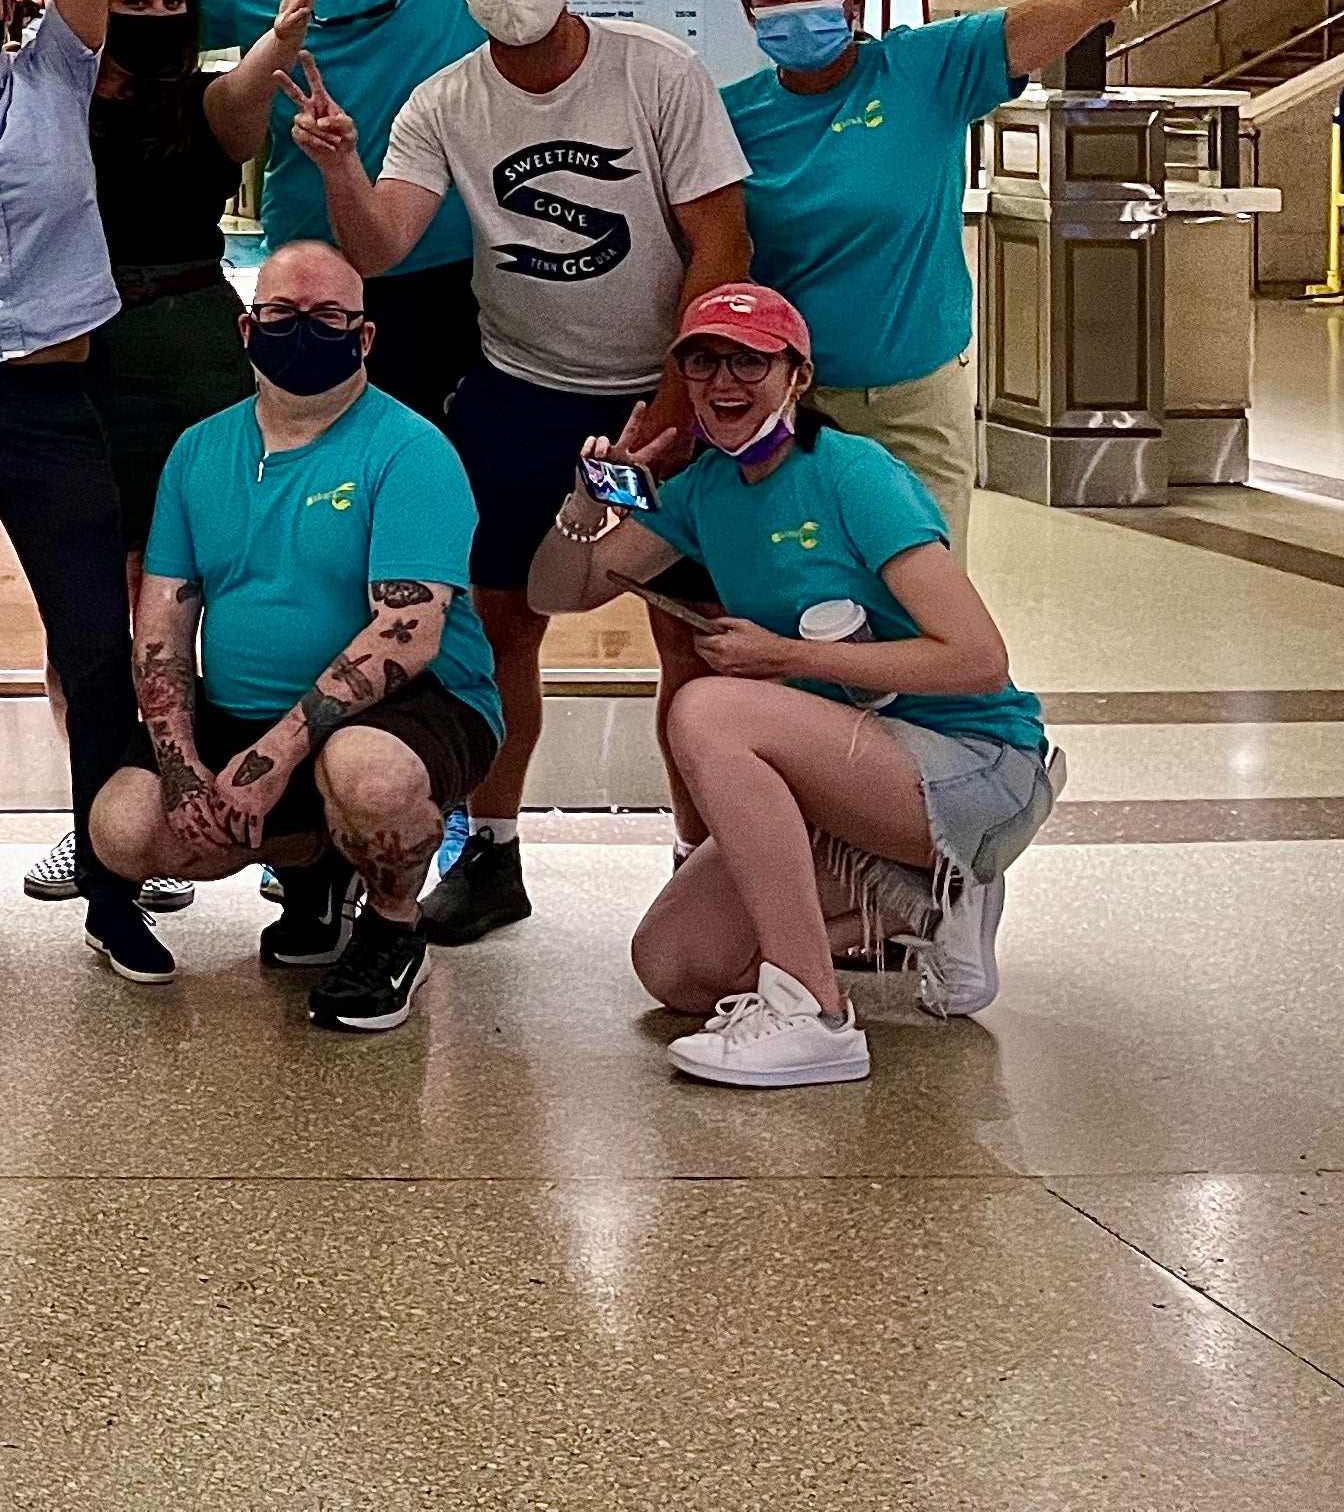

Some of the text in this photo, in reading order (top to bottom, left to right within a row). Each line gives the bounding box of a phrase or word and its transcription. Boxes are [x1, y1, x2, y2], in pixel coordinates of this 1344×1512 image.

[504, 149, 600, 182] SWEETENS
[533, 198, 588, 227] COVE
[562, 256, 596, 276] GC
